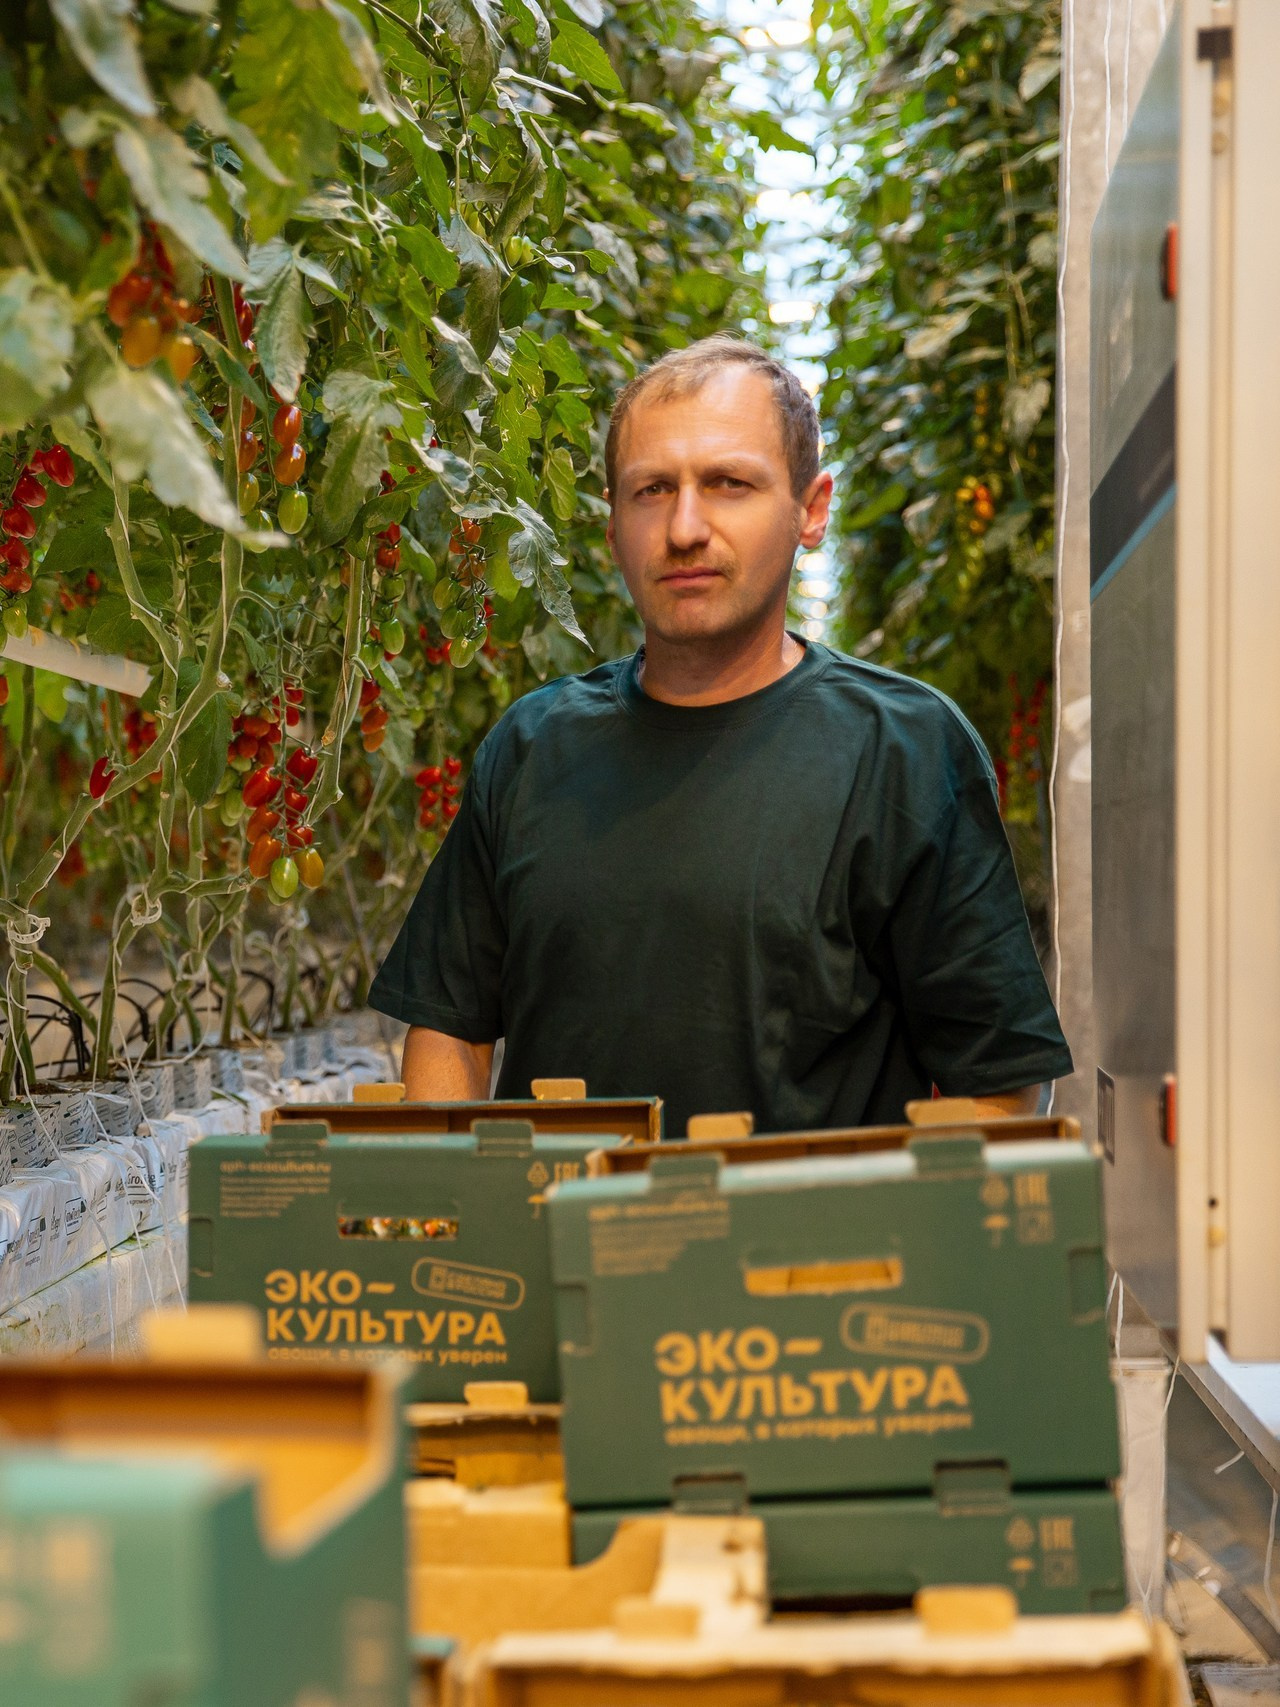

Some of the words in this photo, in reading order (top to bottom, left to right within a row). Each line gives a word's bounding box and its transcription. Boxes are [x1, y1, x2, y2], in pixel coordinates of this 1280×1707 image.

[266, 1308, 507, 1346] КУЛЬТУРА
[438, 1350, 508, 1367] уверен
[659, 1365, 968, 1423] КУЛЬТУРА
